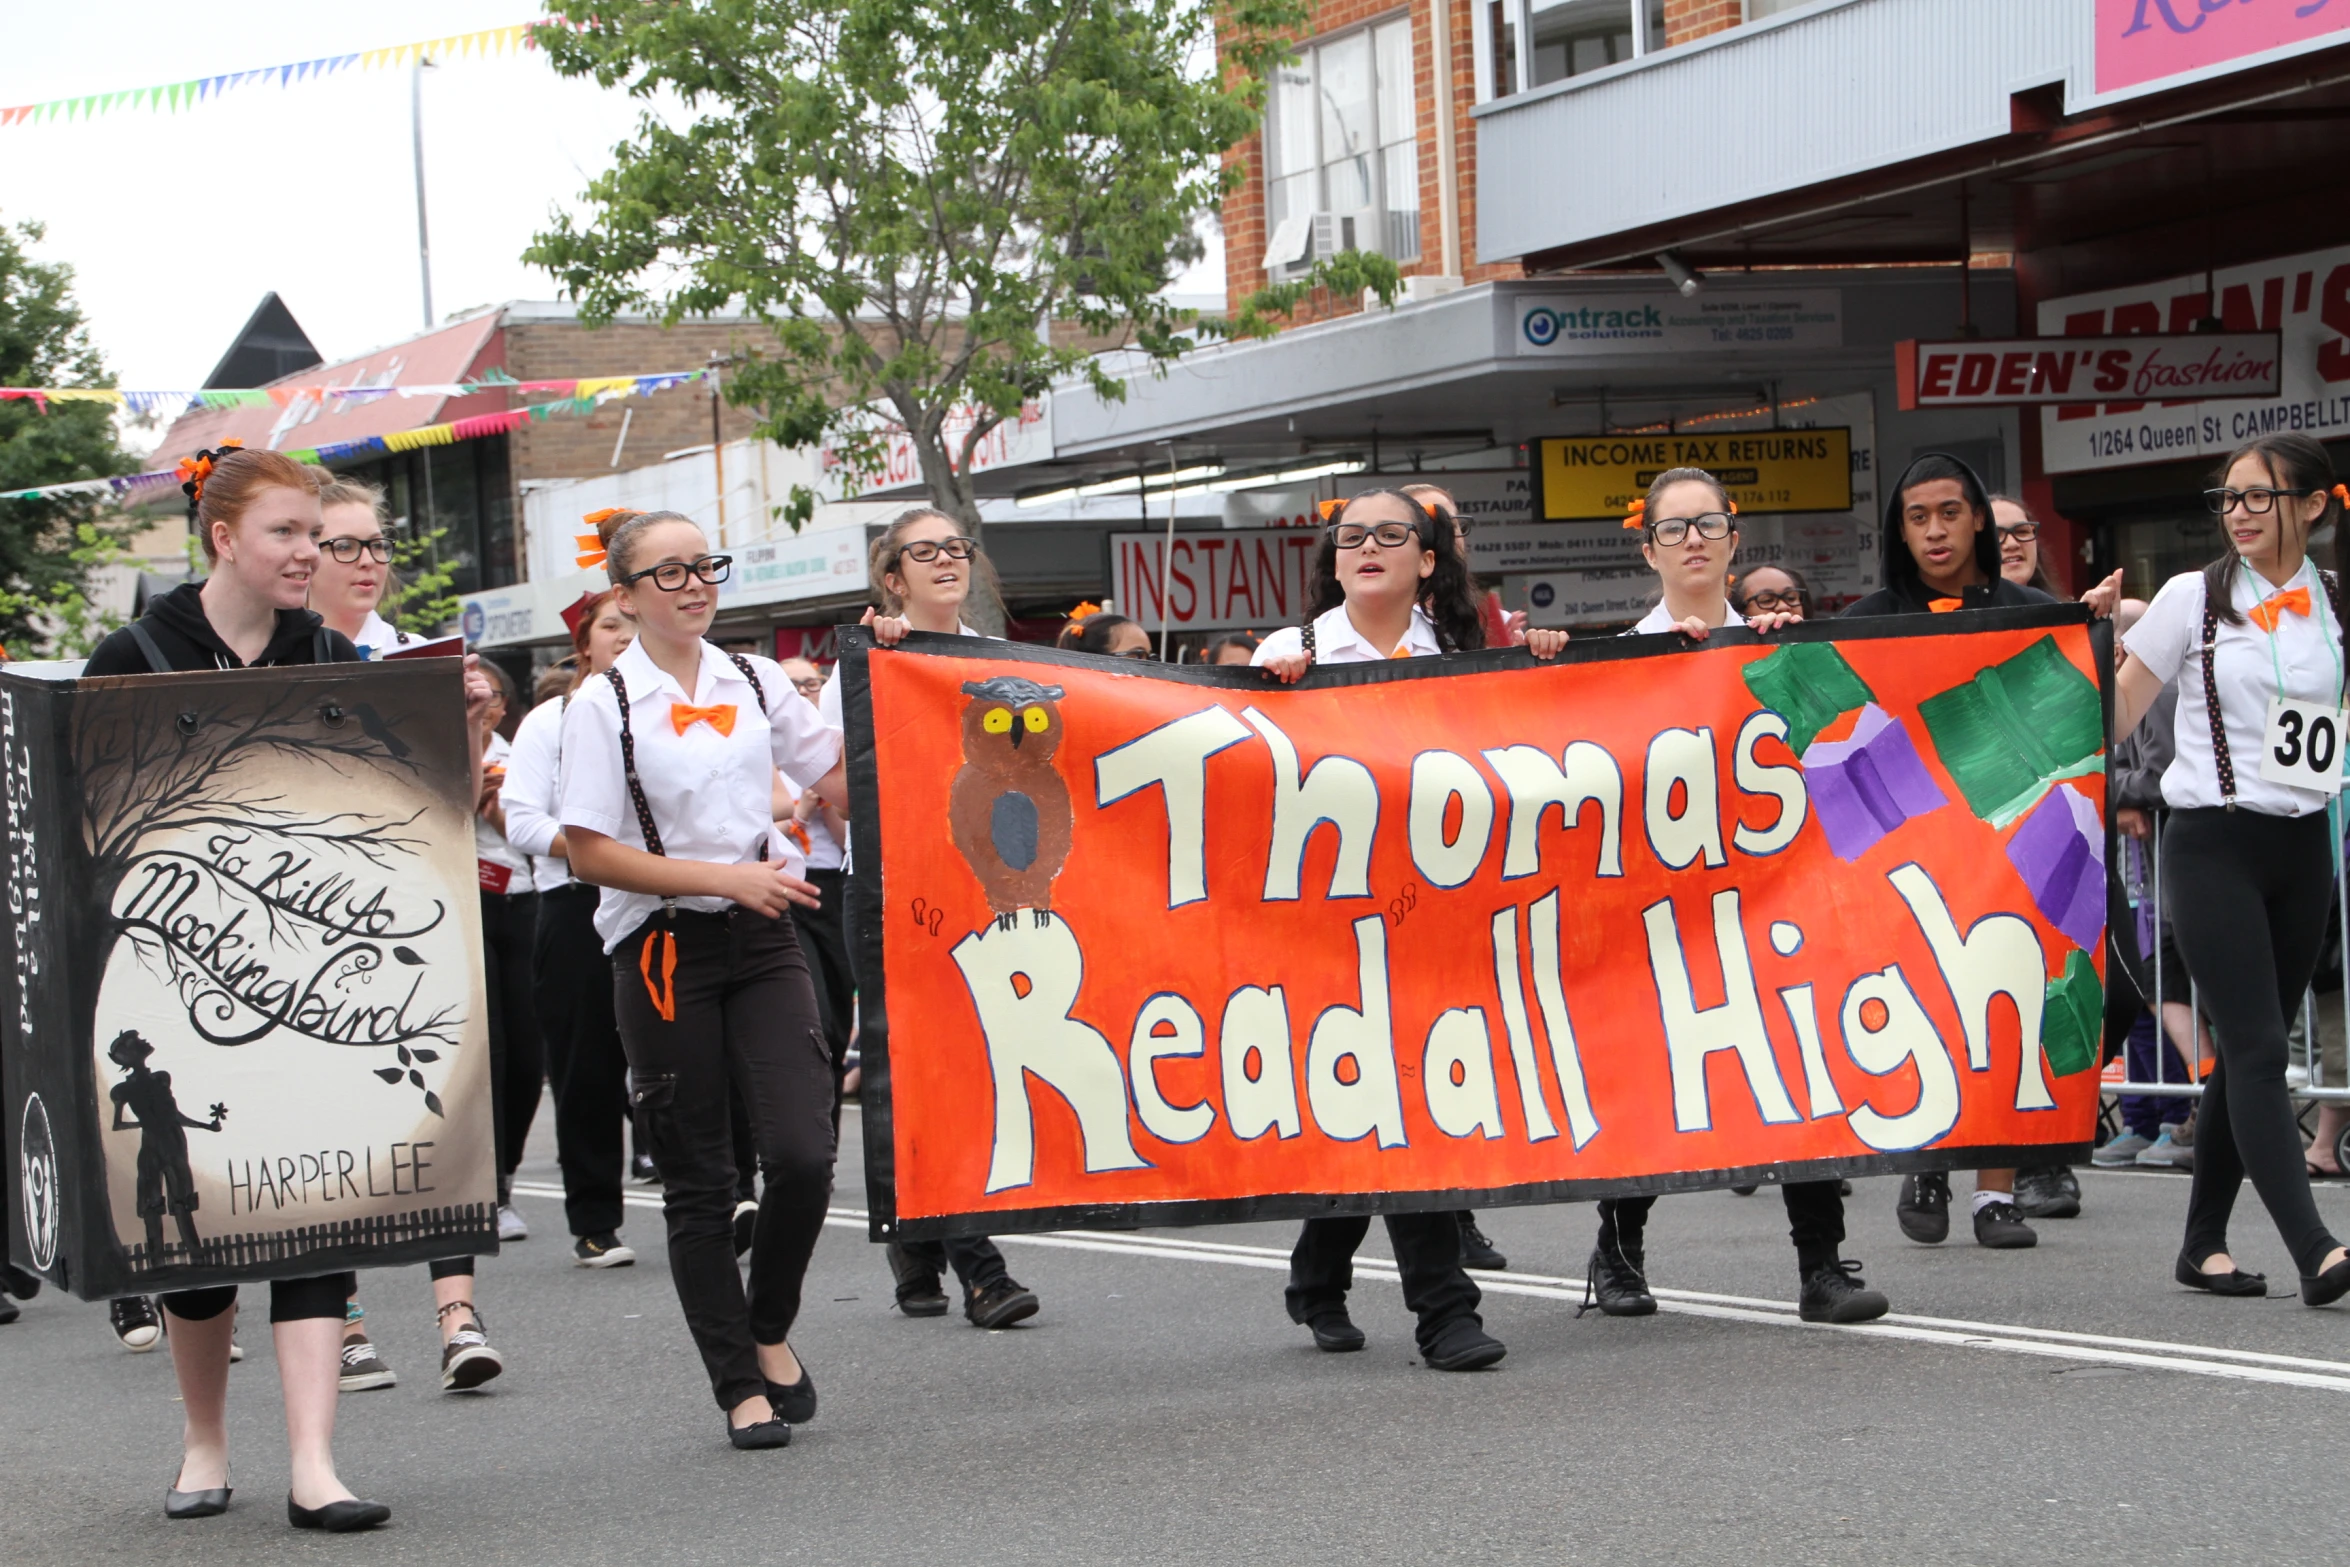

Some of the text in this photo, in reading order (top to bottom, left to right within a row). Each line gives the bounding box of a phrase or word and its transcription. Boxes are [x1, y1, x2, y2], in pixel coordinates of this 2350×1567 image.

[1567, 329, 1664, 341] solutions
[1920, 345, 2274, 397] EDEN'S fashion
[1563, 436, 1828, 467] INCOME TAX RETURNS
[2089, 426, 2134, 458] 1/264
[2139, 424, 2197, 451] Queen
[2203, 416, 2222, 443] St
[1743, 490, 1765, 504] 176
[1769, 489, 1791, 503] 112
[2273, 709, 2337, 774] 30
[1093, 702, 1809, 911] Thomas
[207, 834, 253, 878] To
[254, 850, 355, 923] Kill
[950, 861, 2058, 1196] Readall High
[228, 1141, 436, 1216] HARPER LEE
